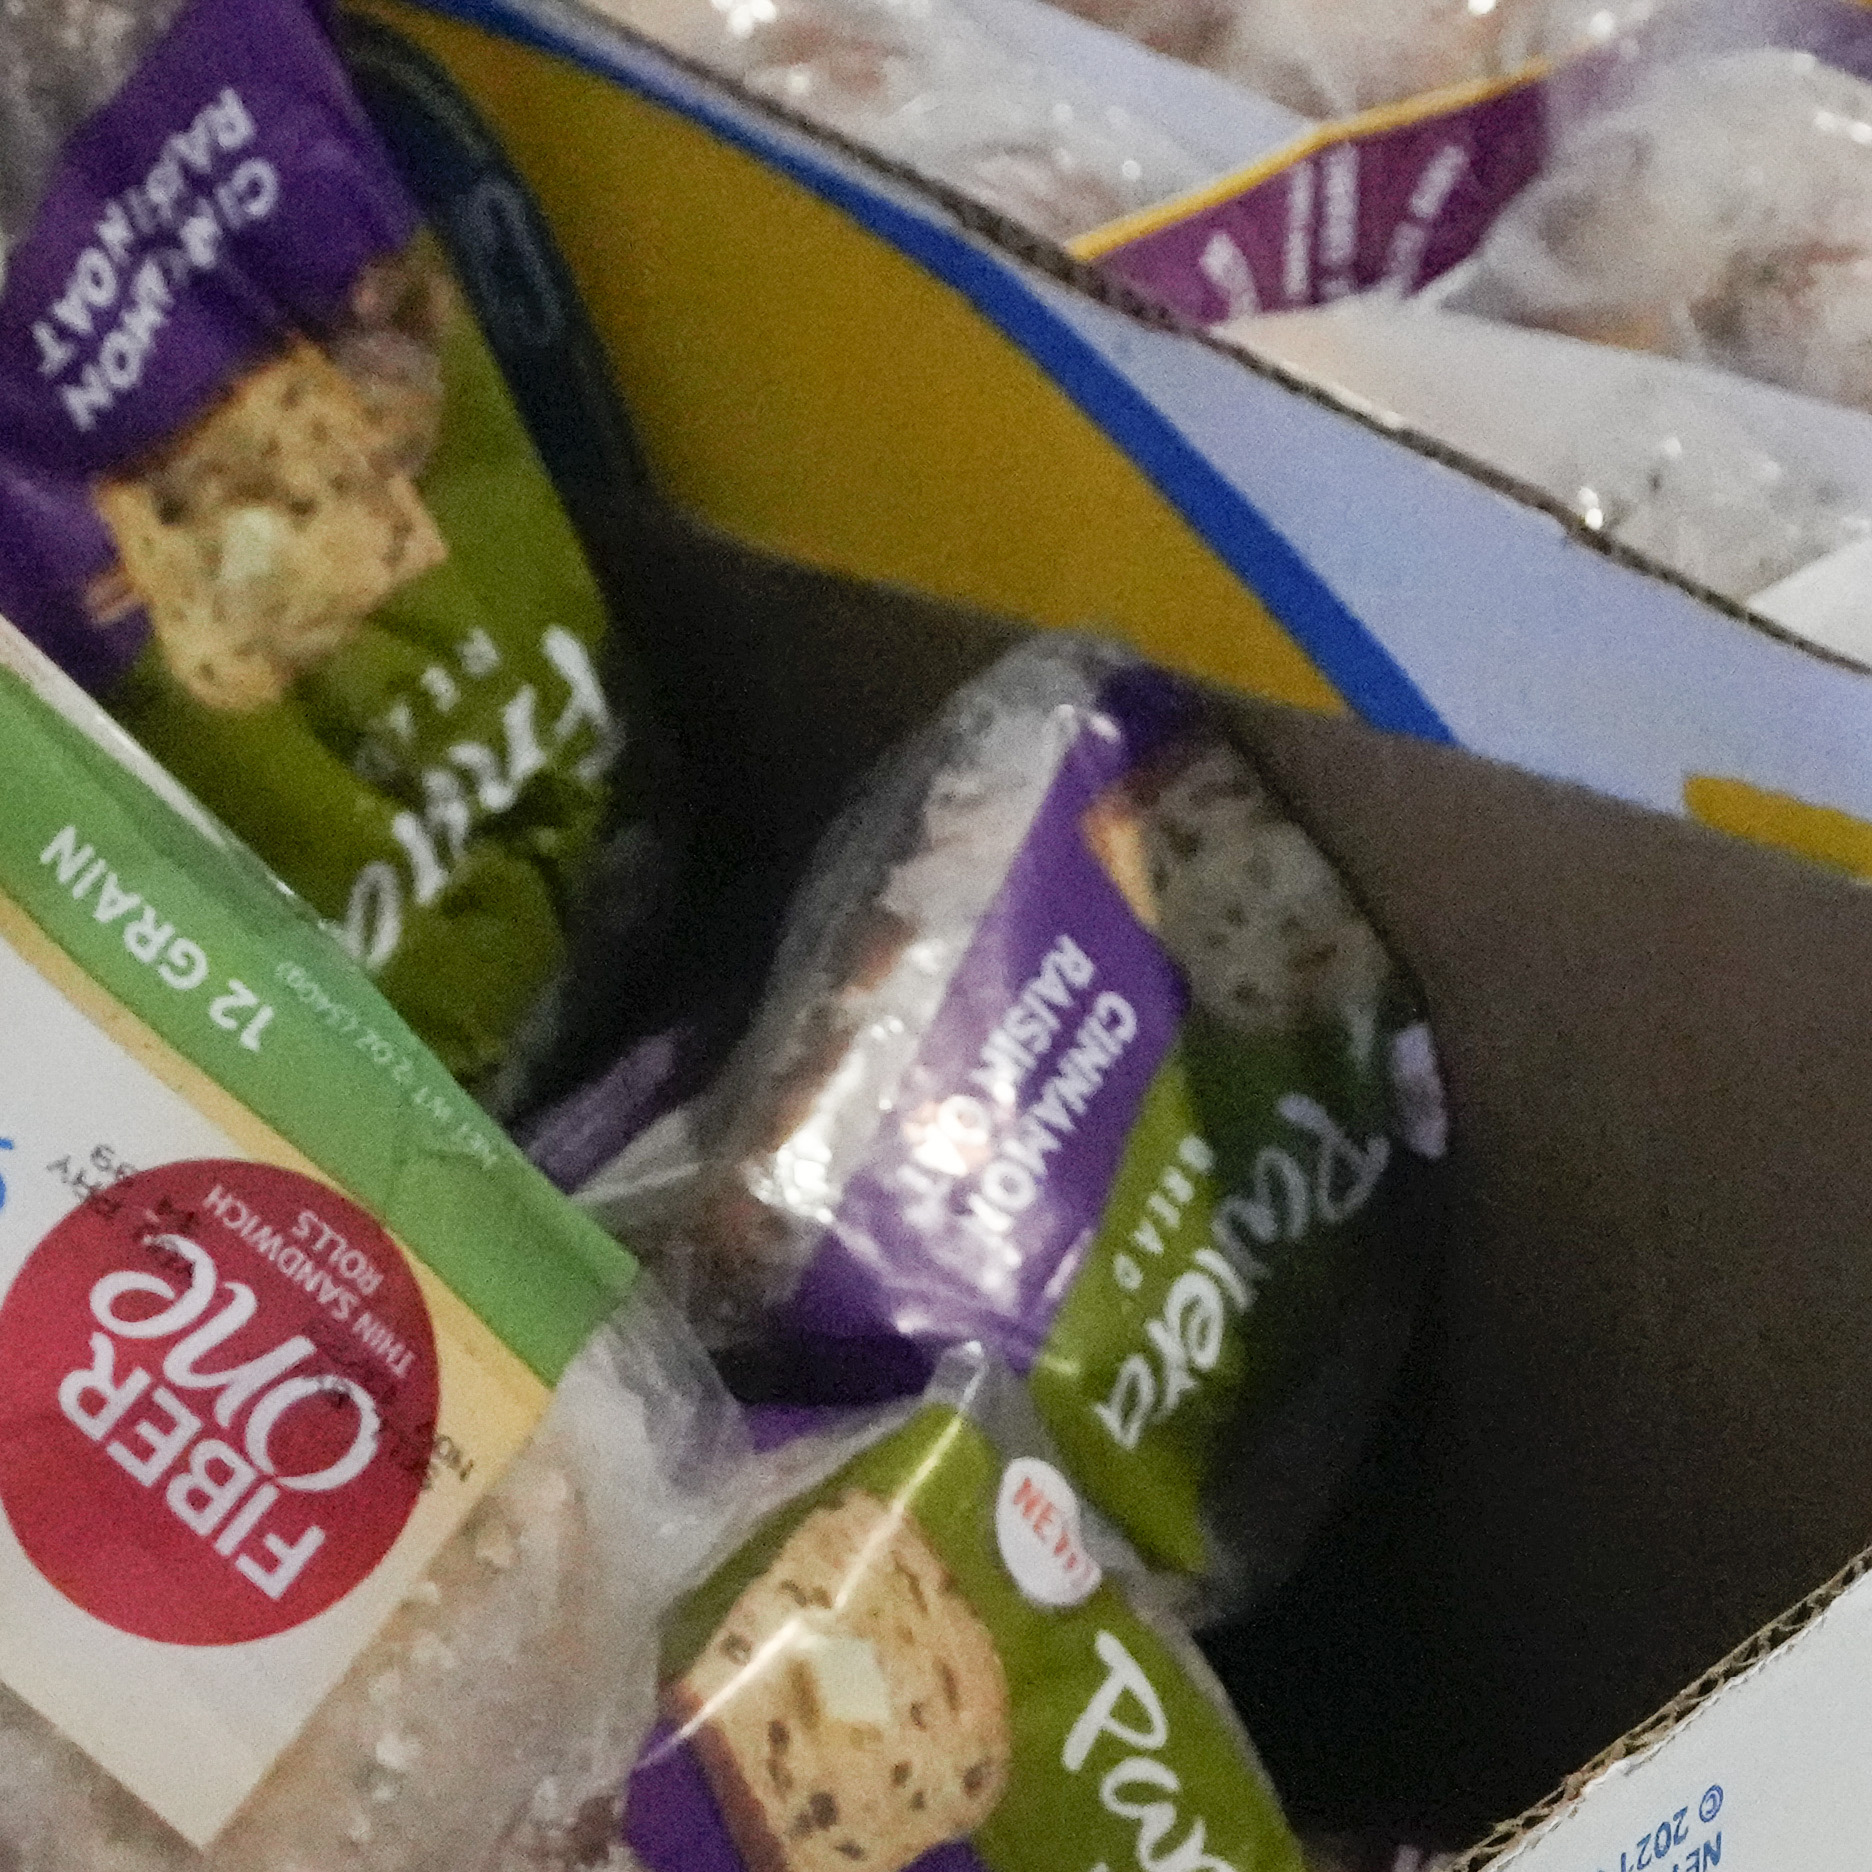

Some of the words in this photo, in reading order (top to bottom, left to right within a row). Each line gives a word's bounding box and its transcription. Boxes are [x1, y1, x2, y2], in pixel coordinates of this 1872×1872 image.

[39, 825, 214, 991] GRAIN
[209, 979, 274, 1053] 12
[200, 1184, 362, 1322] SANDWICH
[290, 1208, 386, 1297] ROLLS
[1095, 1093, 1393, 1450] Panera
[352, 1309, 417, 1380] THIN
[57, 1332, 326, 1602] FIBER
